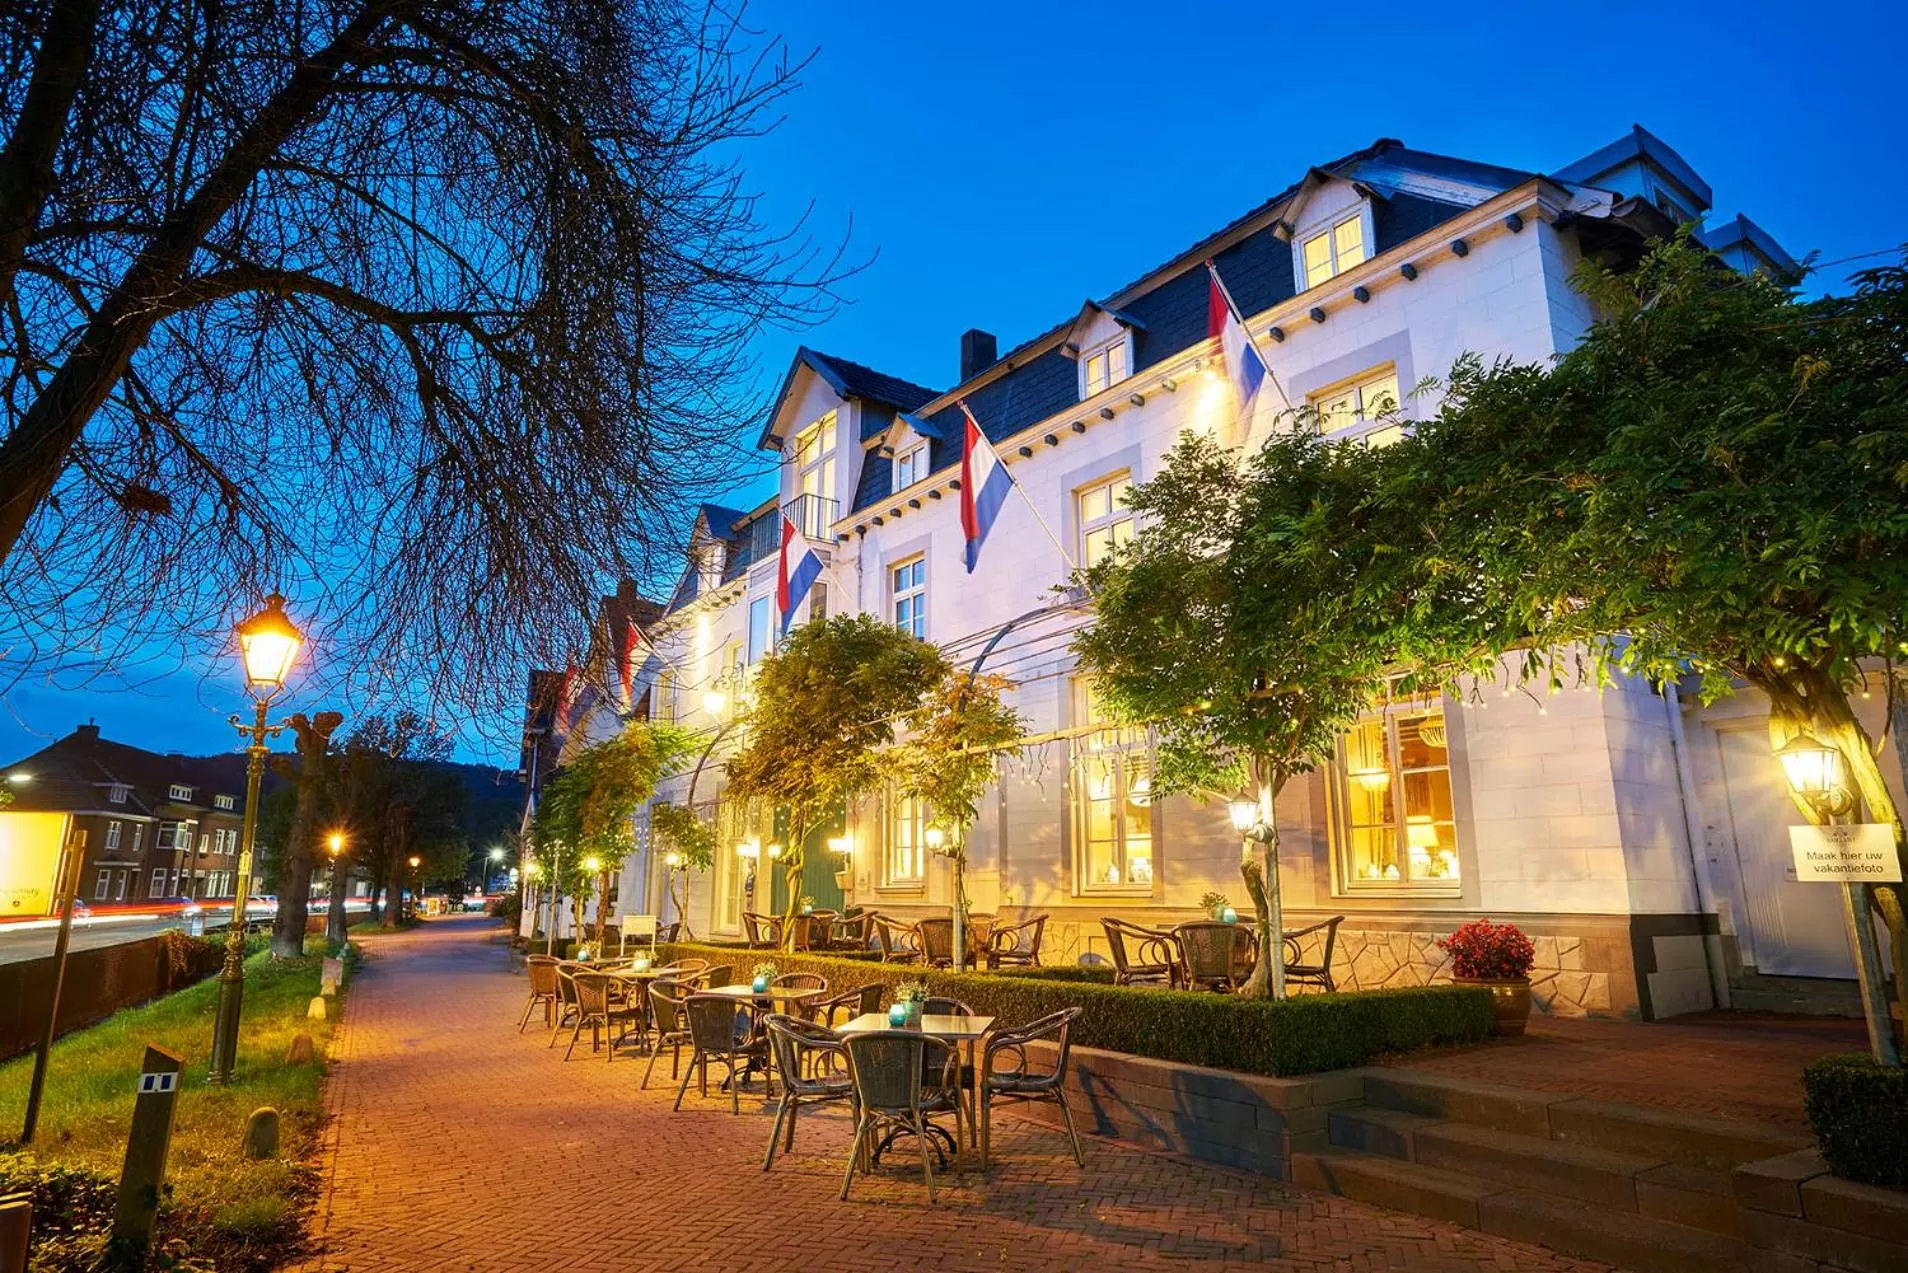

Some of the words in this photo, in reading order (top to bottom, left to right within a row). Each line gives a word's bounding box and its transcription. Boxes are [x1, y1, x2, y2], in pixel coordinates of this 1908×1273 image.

[1806, 851, 1837, 860] Maak
[1841, 851, 1862, 860] hier
[1865, 852, 1883, 860] uw
[1813, 863, 1884, 873] vakantiefoto
